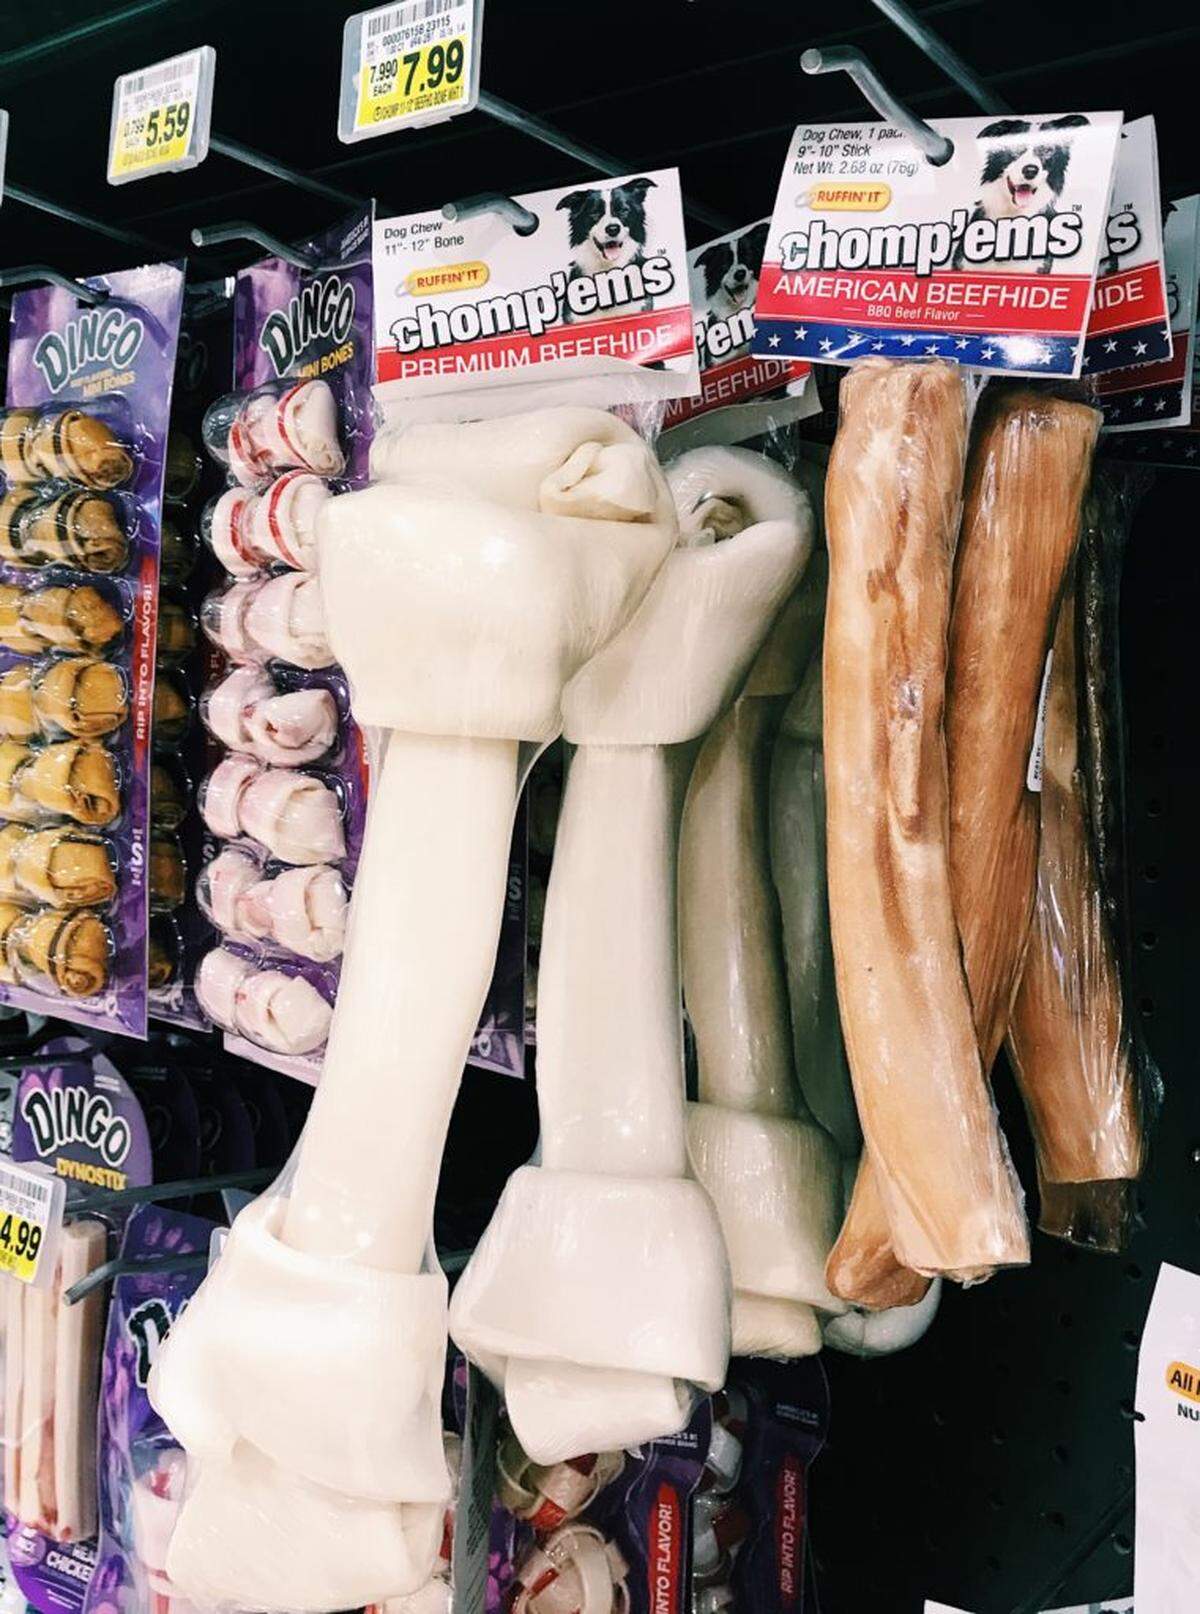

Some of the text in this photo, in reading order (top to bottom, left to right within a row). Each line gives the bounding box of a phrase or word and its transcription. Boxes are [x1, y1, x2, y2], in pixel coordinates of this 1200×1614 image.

[403, 39, 464, 96] 7.99
[145, 101, 190, 147] 5.59
[802, 127, 906, 143] Dog Chew, 1 pac
[793, 161, 813, 175] Net
[838, 160, 867, 175] 2.68
[870, 163, 883, 174] oz
[842, 143, 872, 157] Stick
[868, 191, 881, 203] IT
[384, 226, 407, 240] Dog
[410, 221, 443, 236] Chew
[434, 234, 465, 249] Bone
[779, 208, 1083, 278] chomp'ems
[467, 269, 481, 281] IT
[772, 274, 1071, 309] AMERICAN BEEFHIDE
[389, 255, 676, 354] chomp'ems
[867, 303, 961, 321] BBQ Beef Flavor
[259, 275, 356, 378] DINGO
[33, 308, 144, 394] DINGO
[321, 341, 354, 373] BONES
[400, 346, 532, 379] PREMIUM
[538, 323, 673, 365] BEEFHIDE
[136, 583, 153, 740] RIP INTO FLAVOR!
[21, 1086, 131, 1168] DINGO
[0, 1214, 42, 1261] 4.99
[1170, 1369, 1194, 1392] All
[657, 1503, 673, 1574] FLAVOR!
[782, 1531, 795, 1568] INTO
[781, 1567, 794, 1594] RIP
